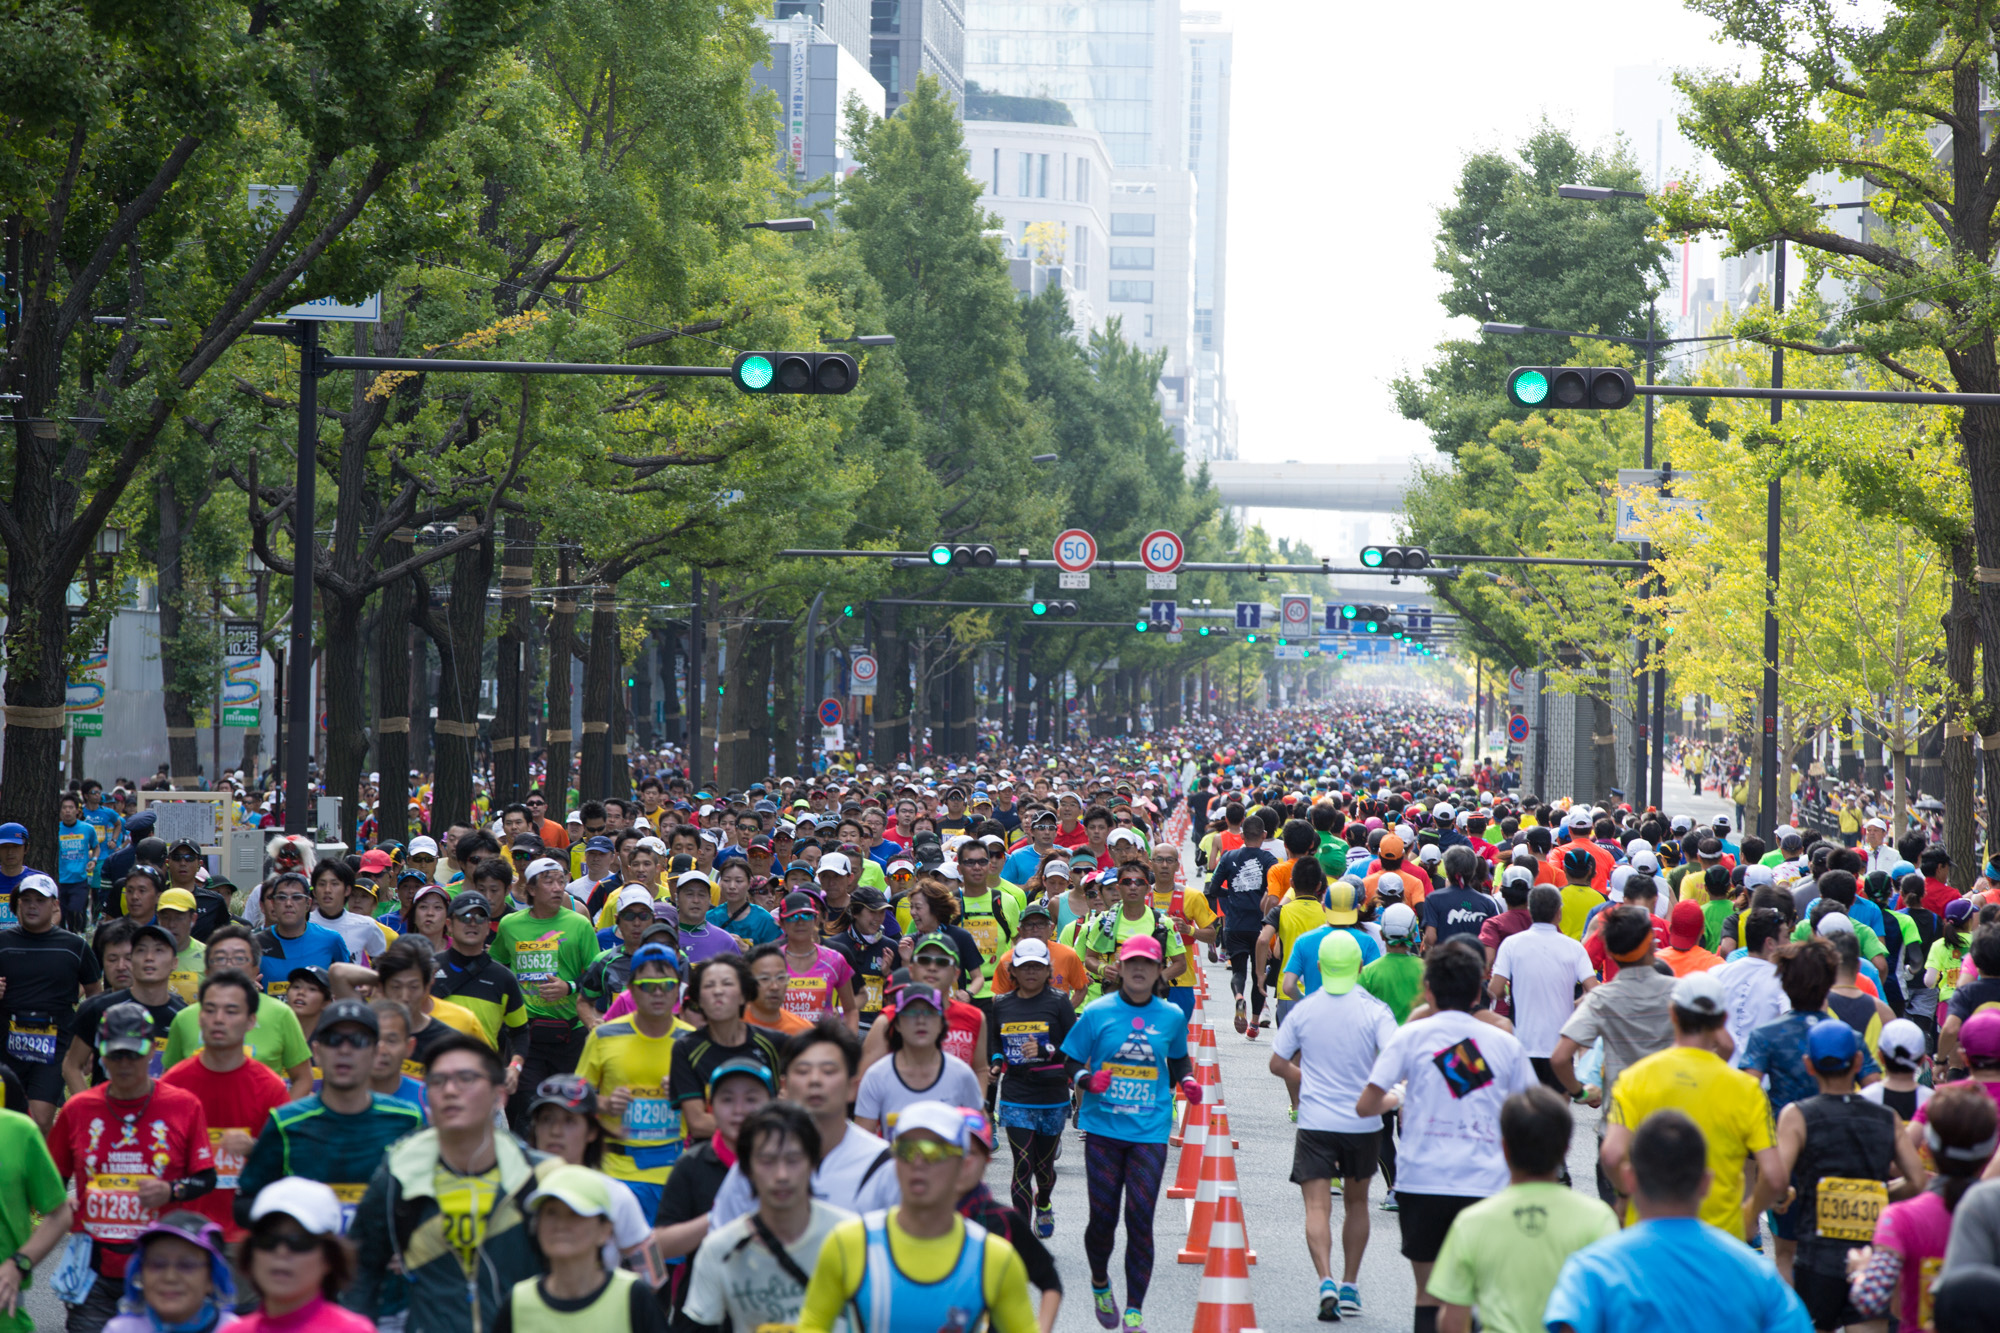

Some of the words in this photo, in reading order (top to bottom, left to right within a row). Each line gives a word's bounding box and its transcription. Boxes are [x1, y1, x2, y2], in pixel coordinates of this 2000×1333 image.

[1064, 542, 1087, 560] 50
[1151, 543, 1174, 561] 60
[1290, 606, 1303, 617] 60
[229, 642, 258, 655] 10.25
[858, 663, 872, 674] 60
[225, 710, 256, 722] mineo
[517, 954, 552, 969] K95632
[8, 1034, 50, 1054] H82926
[1102, 1080, 1151, 1101] 55225
[86, 1193, 149, 1221] G12832
[1822, 1197, 1880, 1222] C30430
